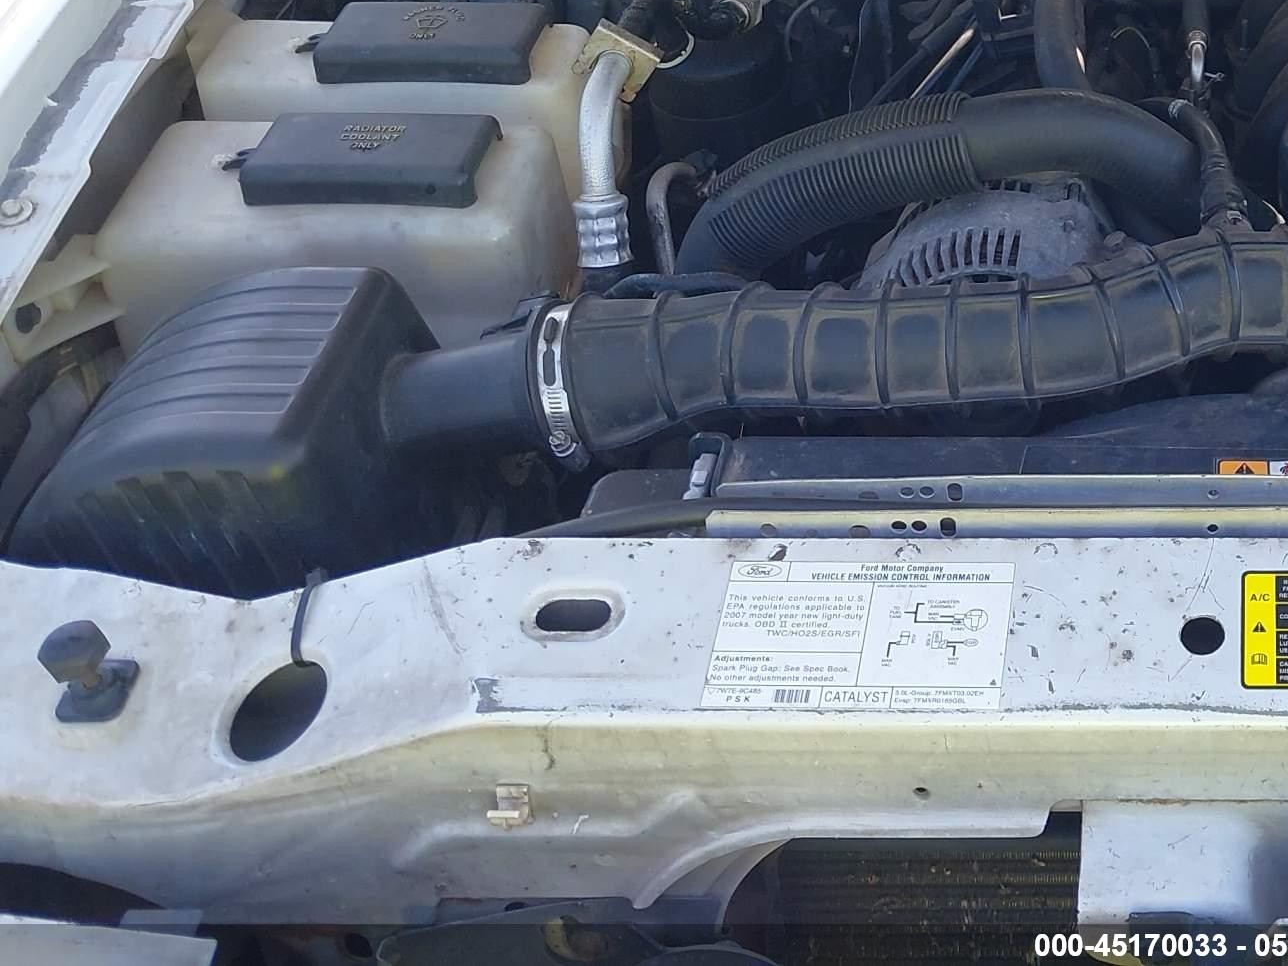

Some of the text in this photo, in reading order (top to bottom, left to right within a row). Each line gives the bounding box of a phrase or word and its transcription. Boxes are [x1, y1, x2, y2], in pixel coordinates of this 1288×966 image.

[344, 124, 406, 132] RADIATOR
[340, 132, 400, 141] COOLANT
[350, 141, 381, 150] ONLY
[746, 565, 772, 576] Ford
[861, 564, 944, 572] Ford Motor Company
[812, 572, 846, 580] VEHICLE
[932, 573, 990, 581] INFORMATION
[729, 594, 865, 602] This vehicle conforms to U.S.
[1250, 594, 1270, 602] A/C
[727, 603, 865, 611] EPA regulations applicable to
[724, 612, 863, 620] 2007 model year new light-duty
[714, 655, 773, 663] Adjustments:
[710, 674, 836, 682] No other adjustments needed.
[824, 691, 888, 703] CATALYST
